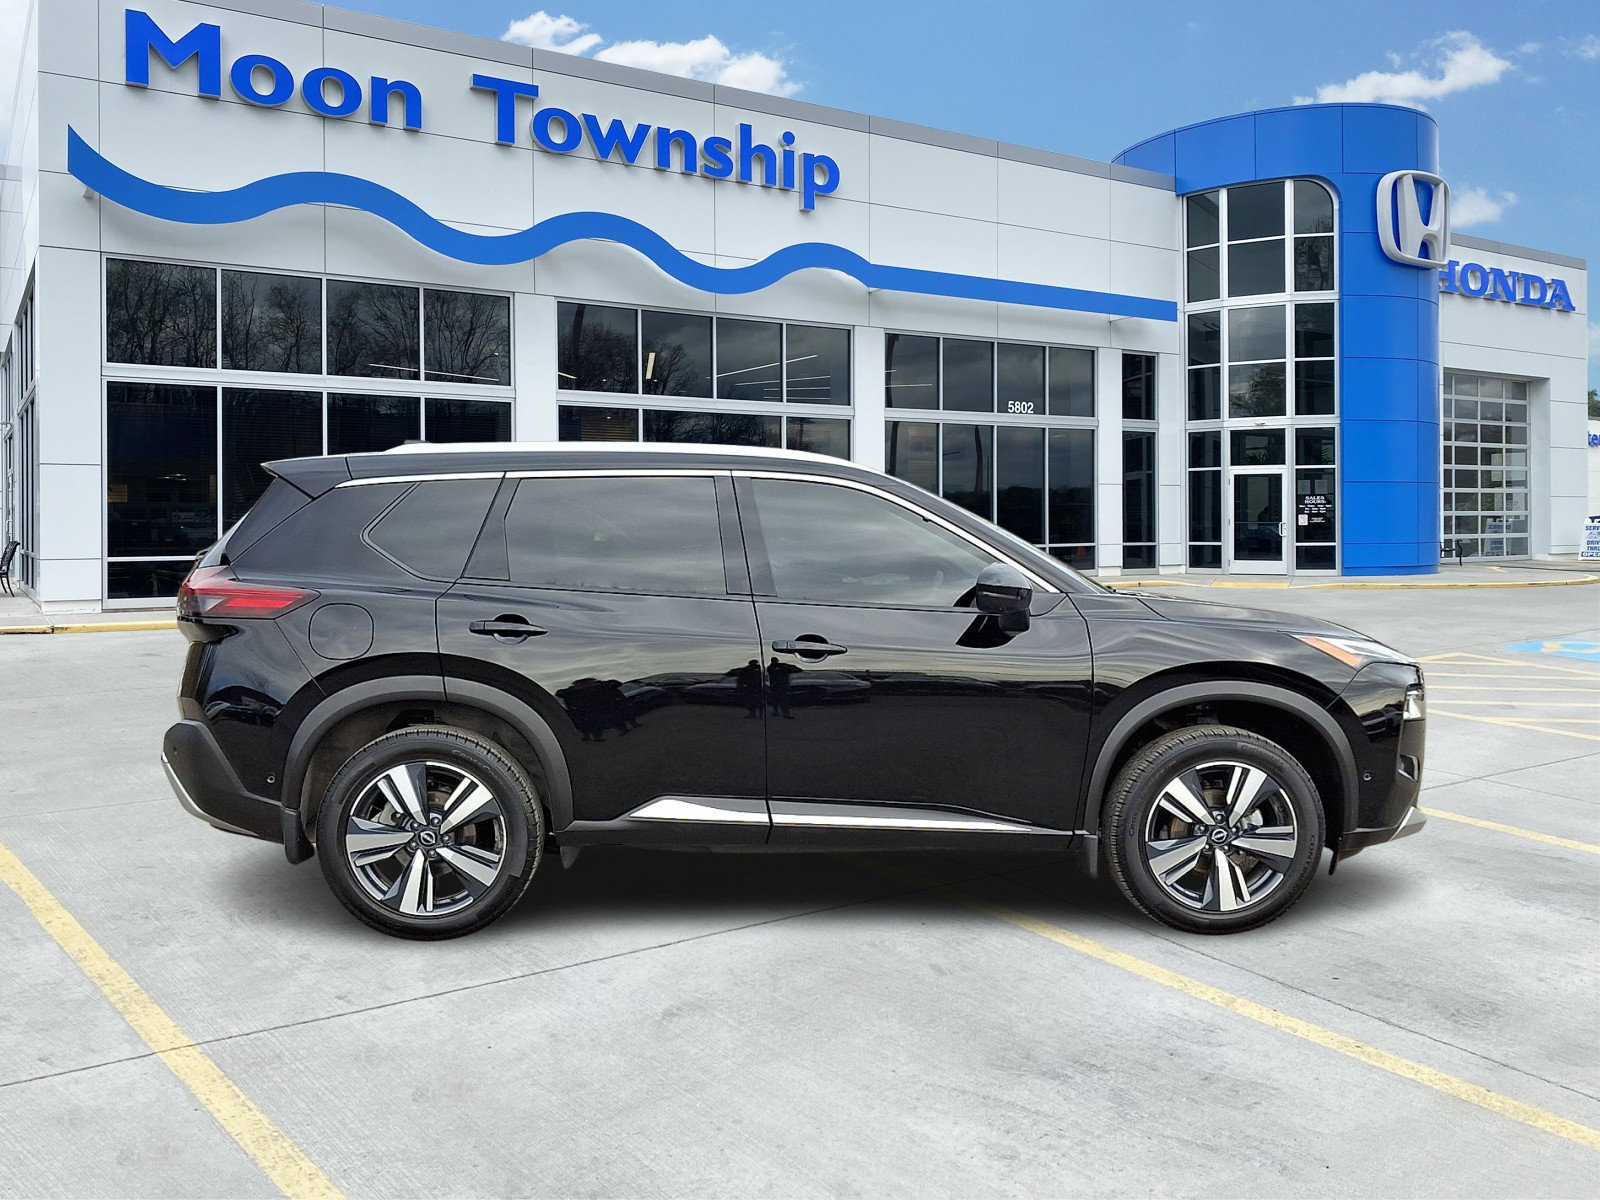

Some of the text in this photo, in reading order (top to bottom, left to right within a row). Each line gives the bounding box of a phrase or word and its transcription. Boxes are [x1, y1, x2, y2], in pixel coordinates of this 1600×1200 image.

[124, 10, 842, 212] Moon Township
[1007, 400, 1034, 414] 5802
